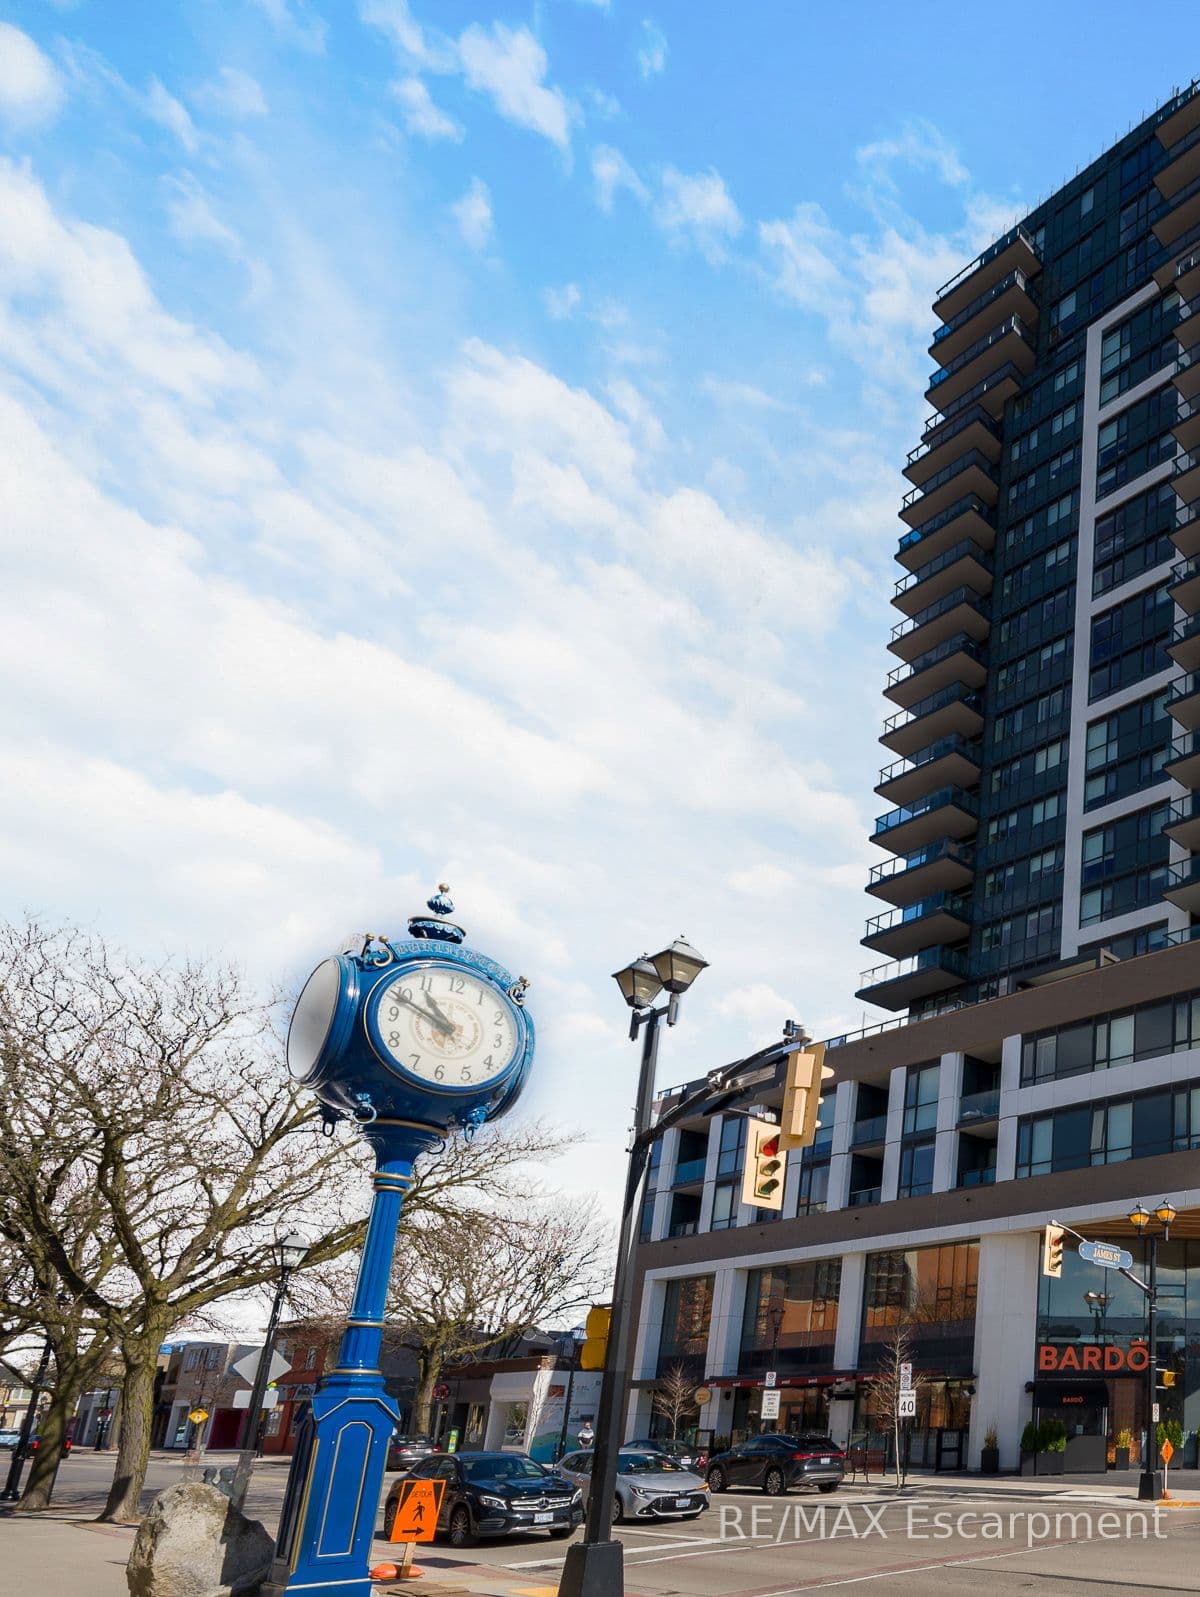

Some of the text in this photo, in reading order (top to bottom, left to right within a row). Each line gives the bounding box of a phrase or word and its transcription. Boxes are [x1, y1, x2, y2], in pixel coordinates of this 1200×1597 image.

[419, 976, 432, 992] 11
[449, 977, 465, 995] 12
[478, 990, 484, 1006] 1
[388, 1006, 400, 1022] 9
[494, 1011, 504, 1026] 2
[388, 1031, 400, 1048] 8
[493, 1033, 502, 1049] 3
[409, 1053, 421, 1071] 7
[483, 1054, 494, 1070] 4
[434, 1064, 445, 1080] 6
[460, 1065, 472, 1081] 5
[1093, 1248, 1113, 1260] JAMES
[900, 1400, 914, 1413] 40
